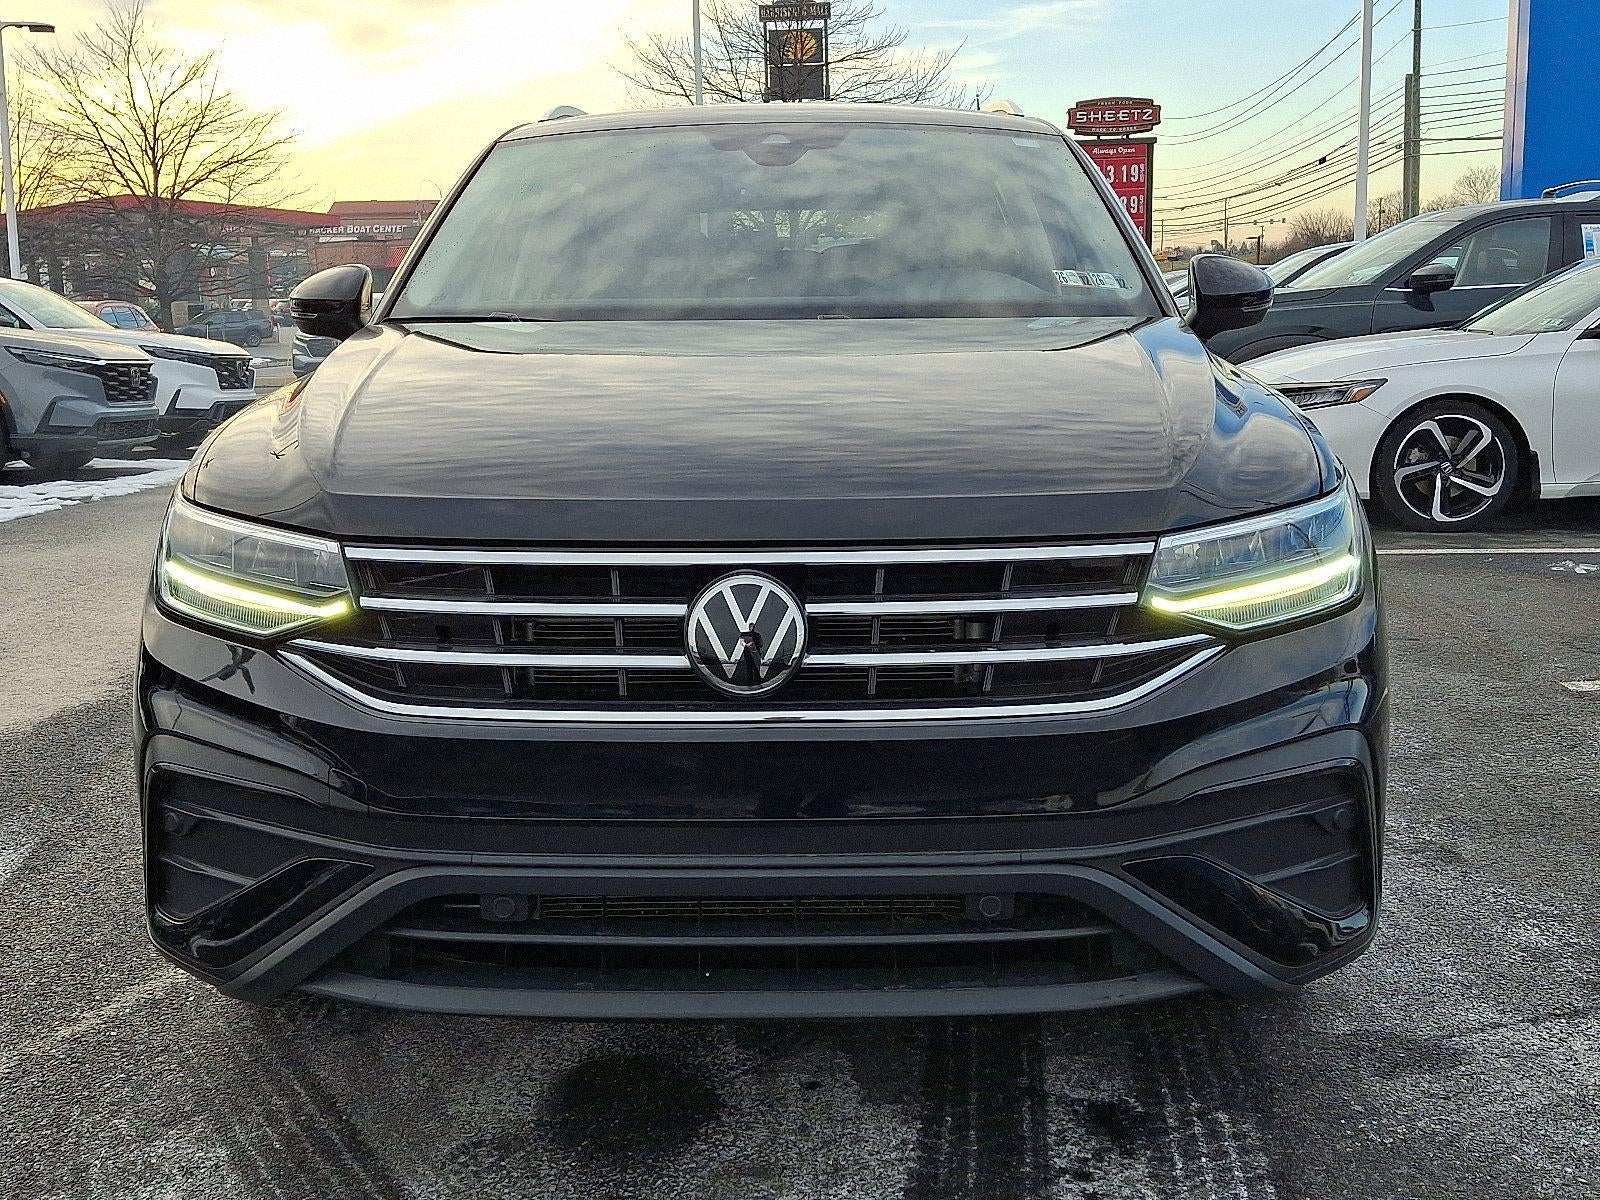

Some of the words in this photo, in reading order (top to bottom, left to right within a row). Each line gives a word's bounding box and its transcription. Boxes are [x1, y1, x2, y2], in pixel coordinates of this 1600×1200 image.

[1076, 109, 1153, 123] SHEETZ
[1092, 147, 1117, 156] Always
[1118, 146, 1136, 154] Open
[346, 224, 371, 234] BOAT
